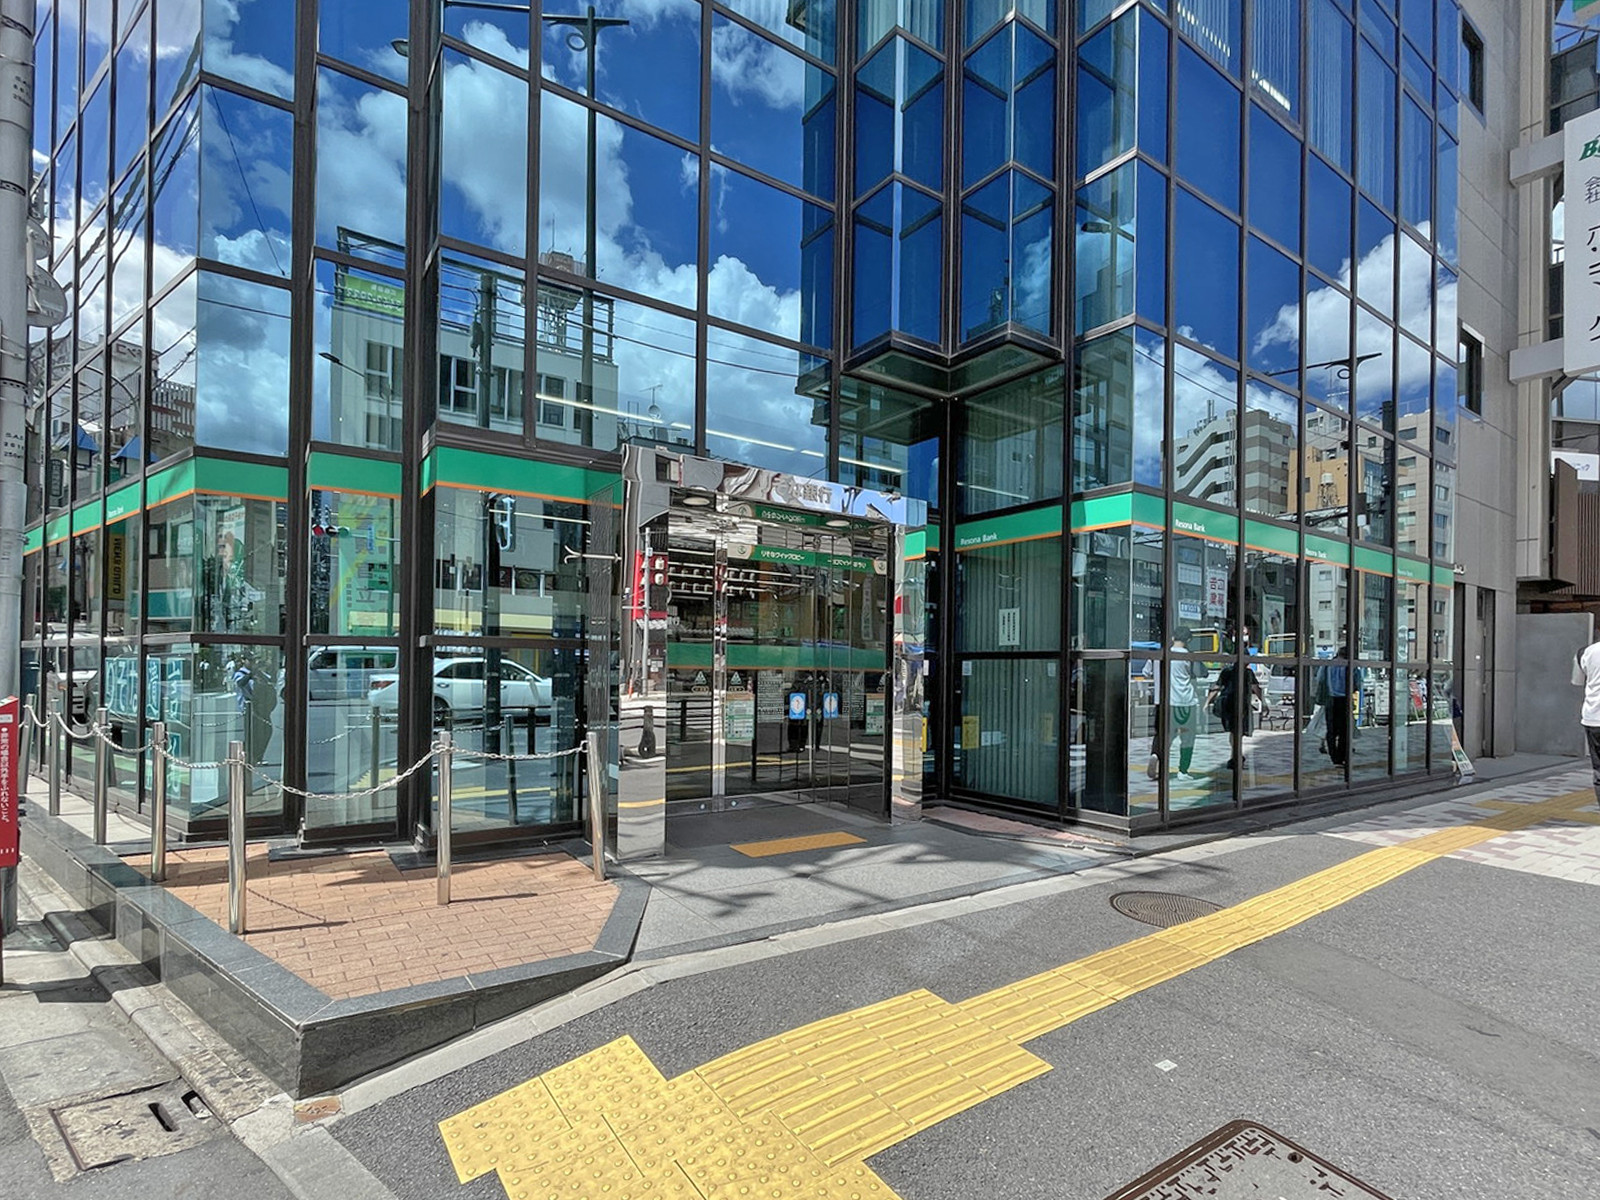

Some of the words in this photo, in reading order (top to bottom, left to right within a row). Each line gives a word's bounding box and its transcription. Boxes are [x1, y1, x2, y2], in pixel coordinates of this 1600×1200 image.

[1578, 134, 1600, 161] B
[1175, 518, 1193, 530] Resona
[1193, 522, 1206, 532] Bank
[960, 535, 982, 546] Resona
[982, 533, 998, 543] Bank
